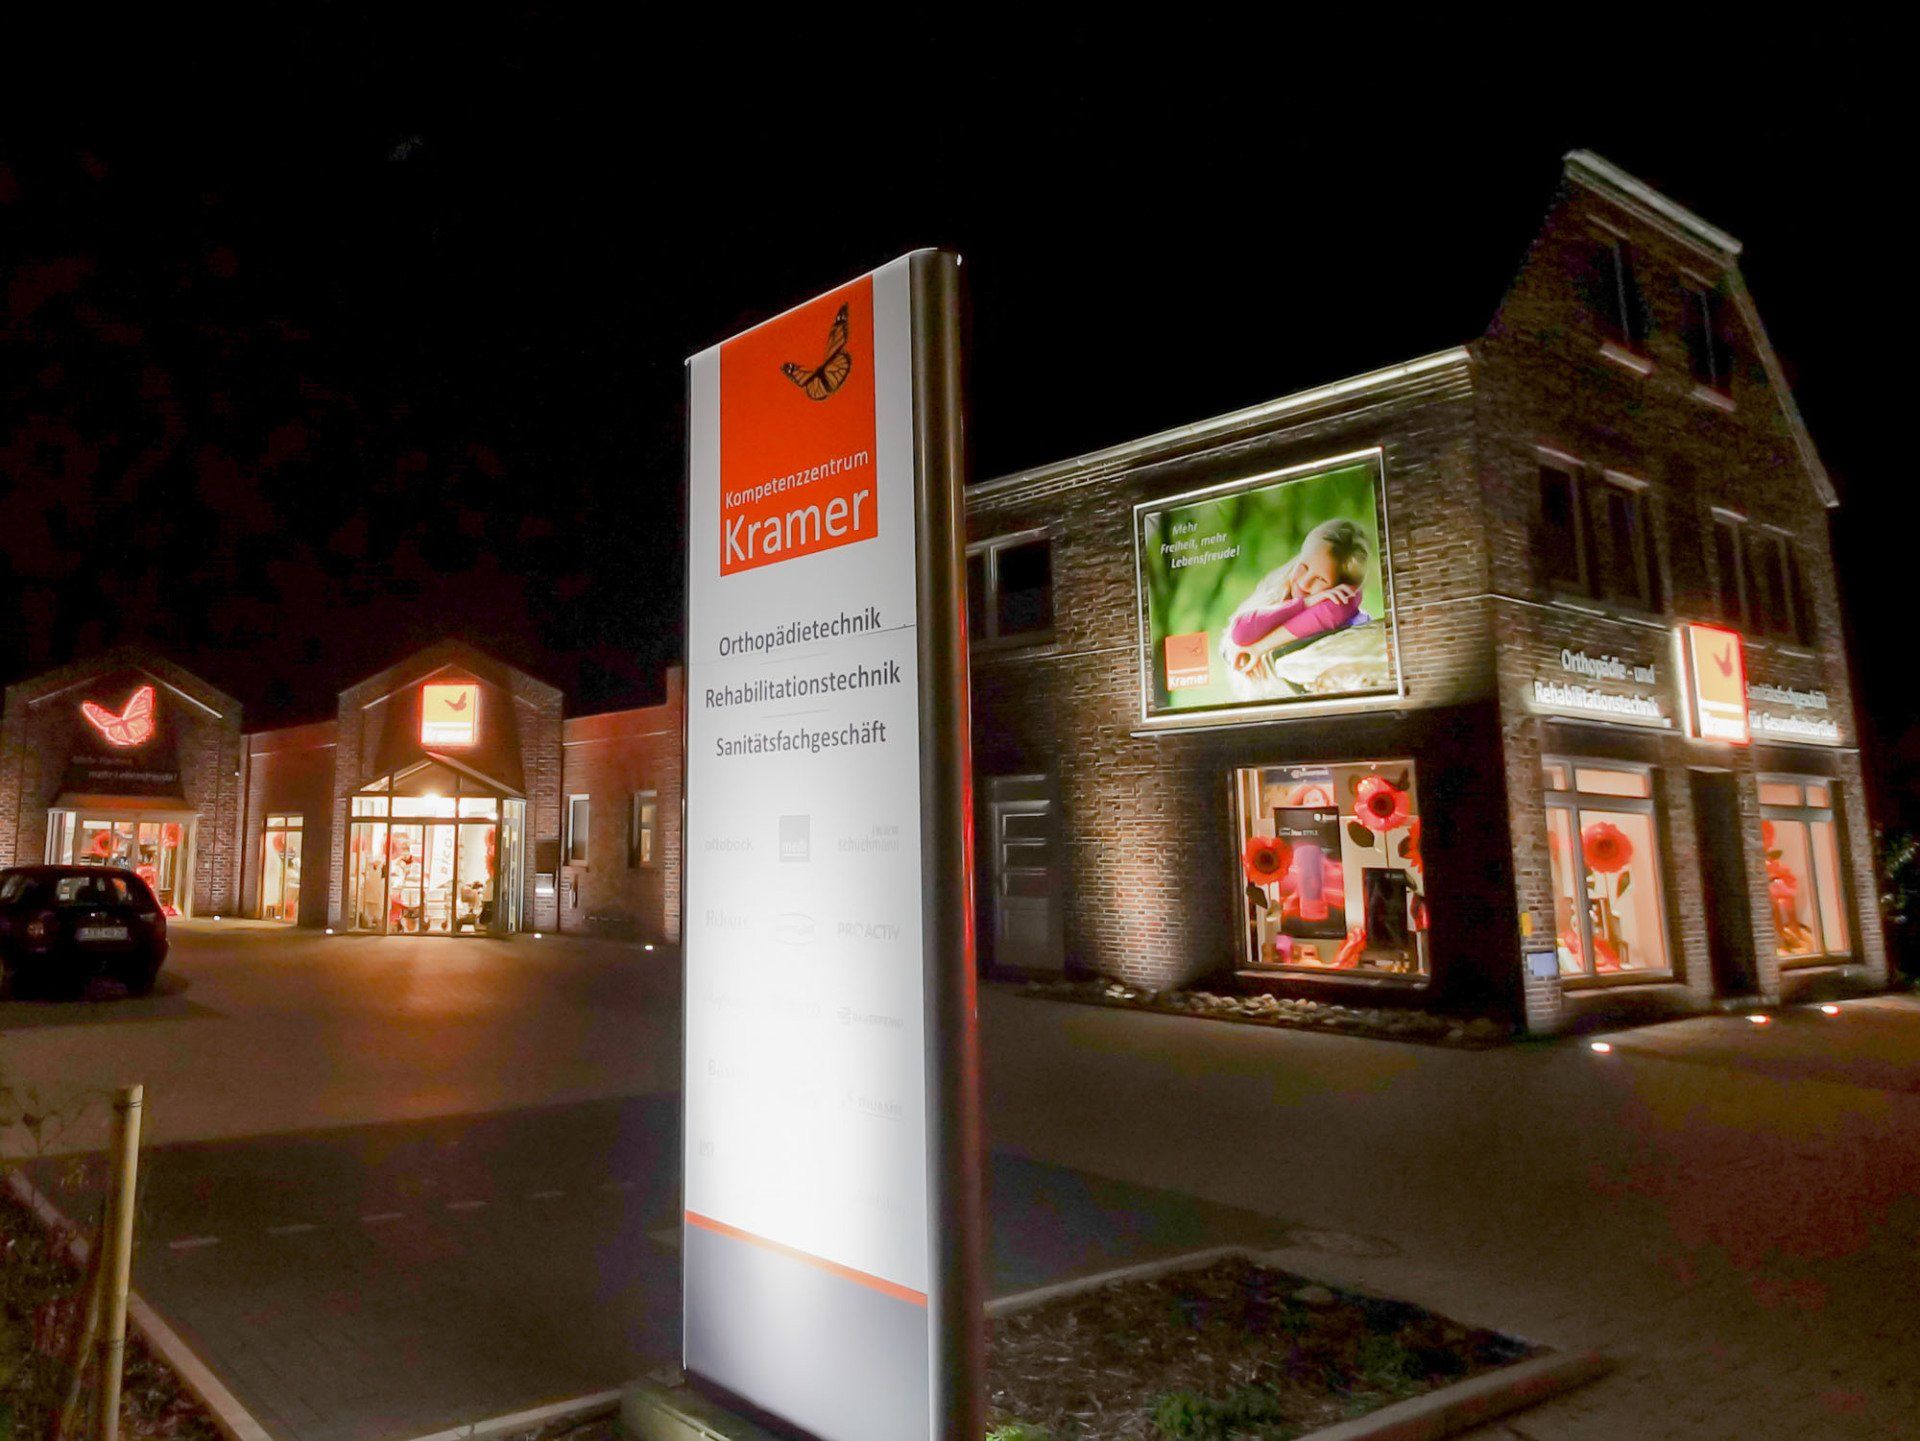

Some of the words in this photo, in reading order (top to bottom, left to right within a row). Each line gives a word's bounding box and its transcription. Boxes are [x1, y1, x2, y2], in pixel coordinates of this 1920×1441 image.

[726, 450, 869, 509] Kompetenzzentrum
[725, 488, 870, 565] Kramer
[1172, 521, 1199, 536] Mehr
[1201, 532, 1228, 546] mehr
[1171, 545, 1241, 569] Lebensfreude!
[719, 606, 882, 656] Orthopädietechnik
[706, 659, 901, 709] Rehabilitationstechnik
[716, 720, 887, 757] Sanitätsfachgeschäft
